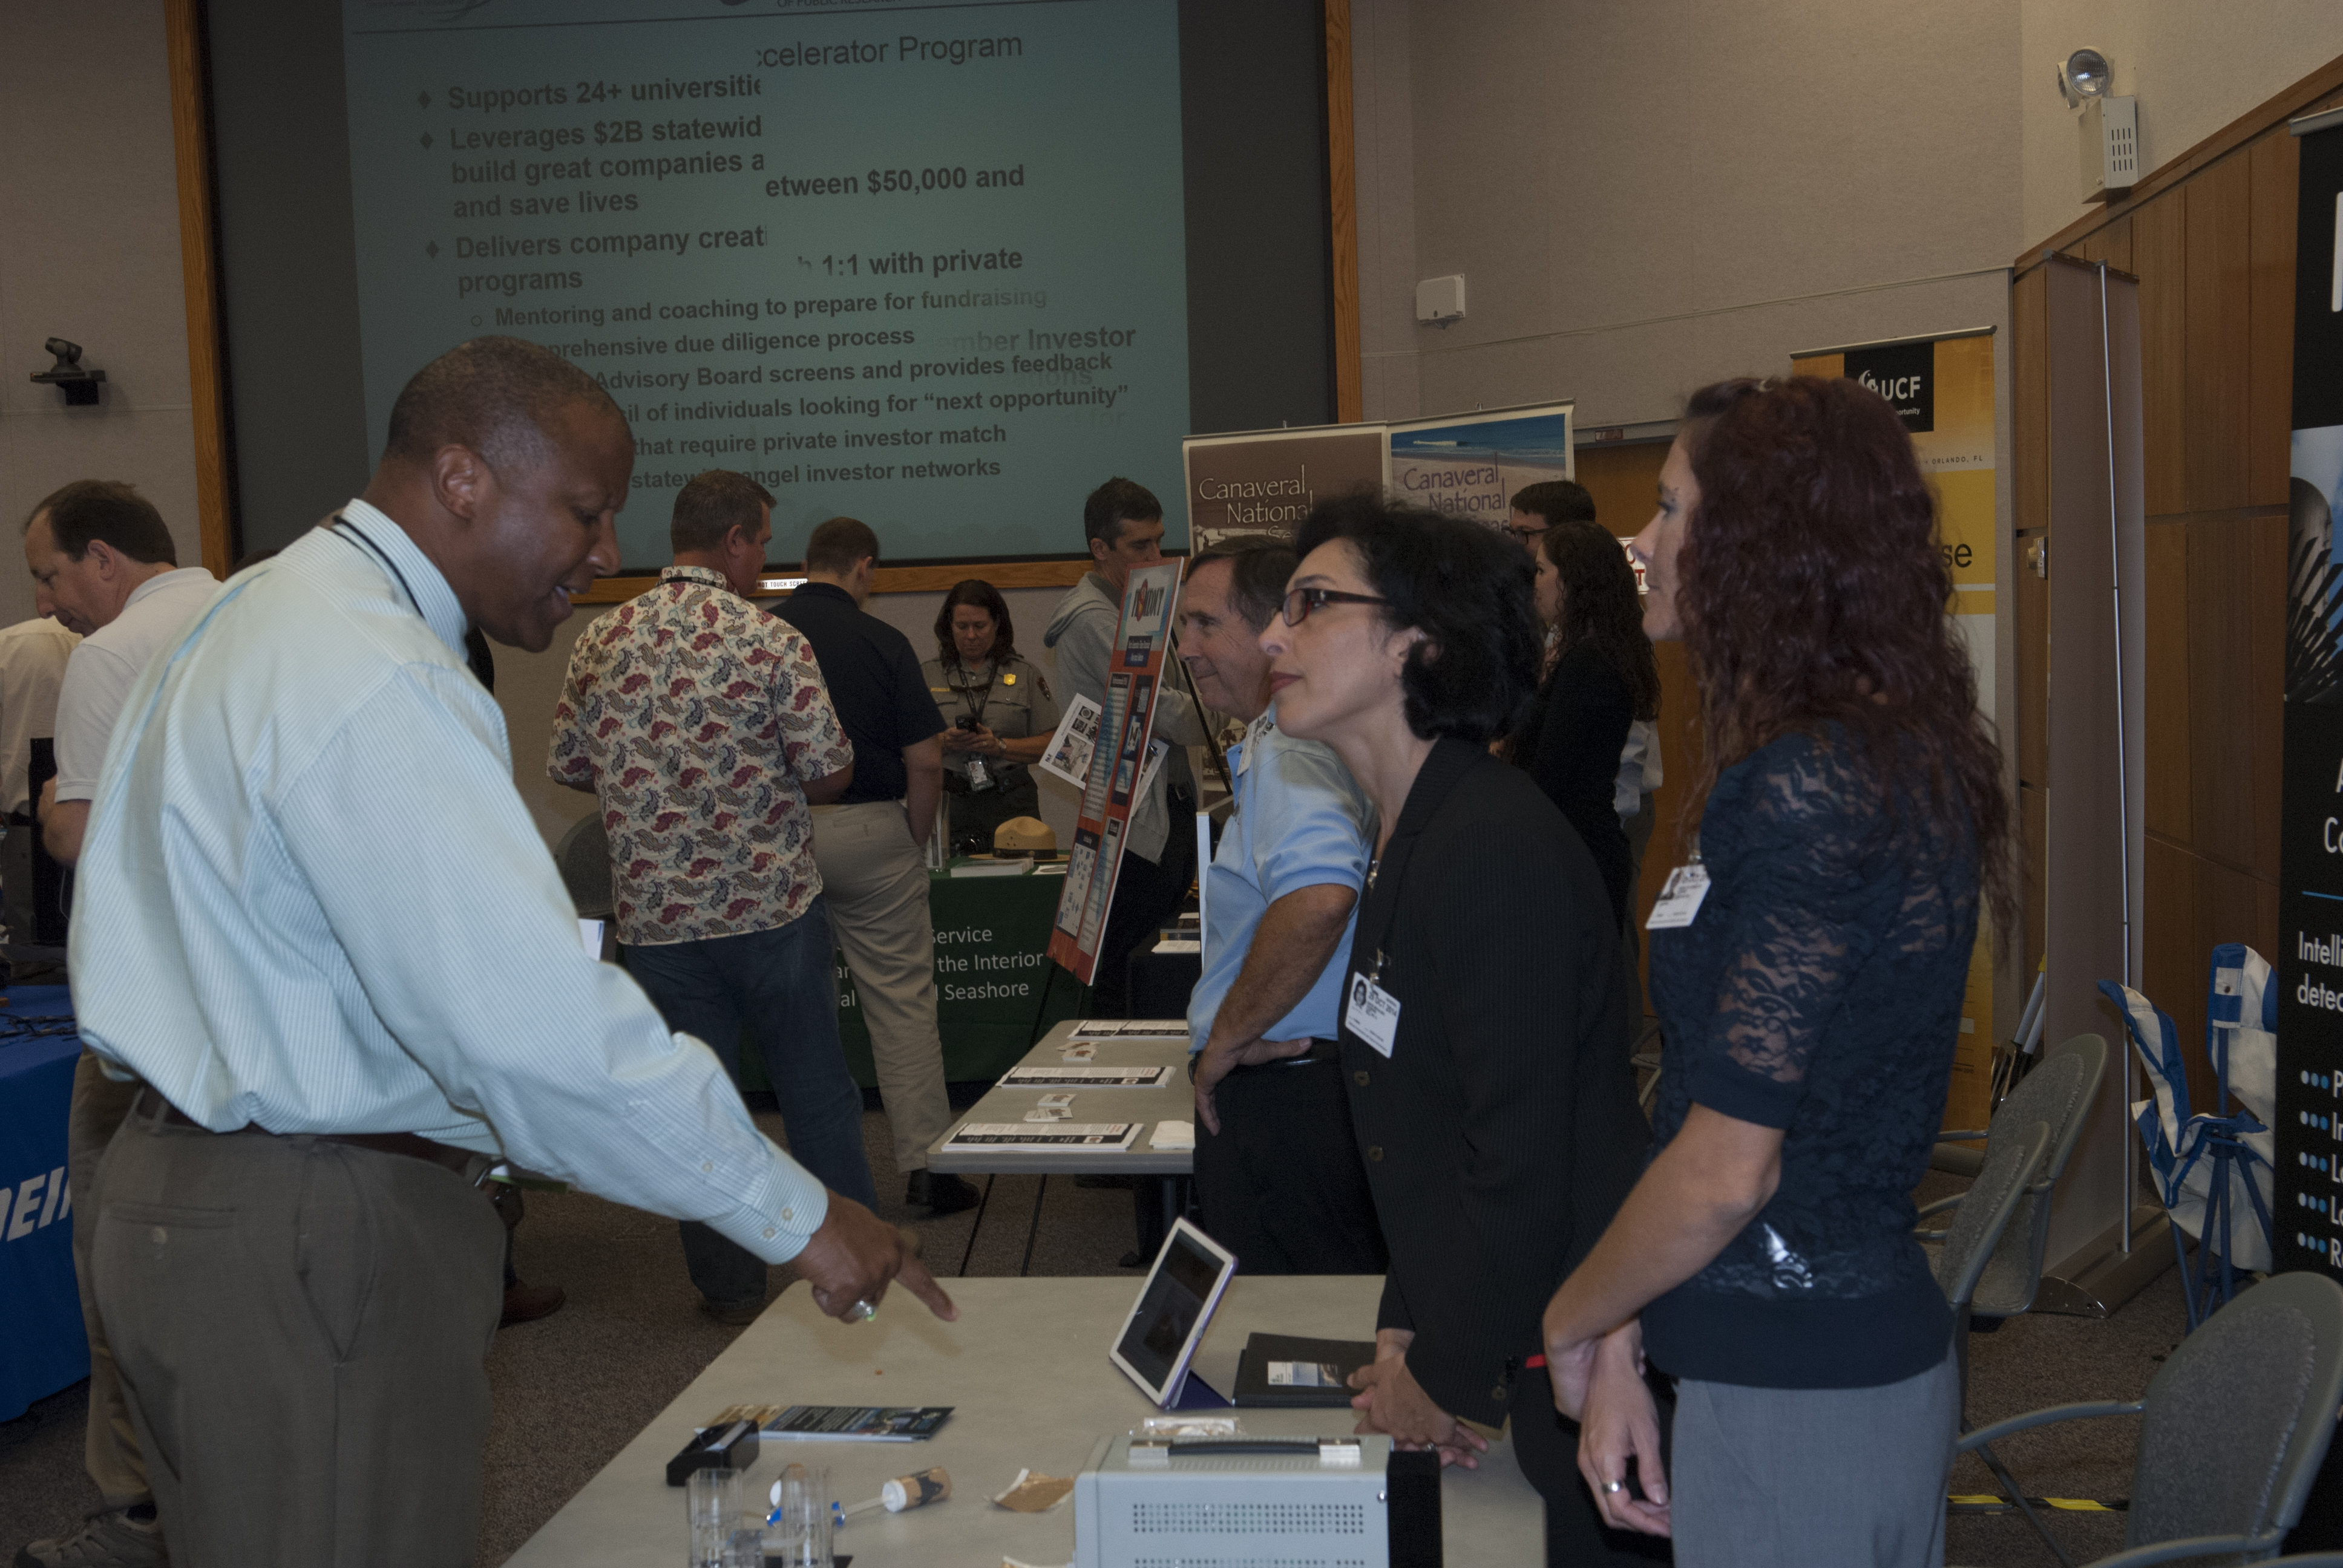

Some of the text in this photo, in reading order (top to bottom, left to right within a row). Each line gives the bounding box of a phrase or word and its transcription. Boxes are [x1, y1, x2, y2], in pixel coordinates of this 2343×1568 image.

[756, 36, 1023, 68] celerator Program
[448, 83, 568, 114] Supports
[576, 80, 622, 104] 24+
[450, 127, 586, 152] Leverages
[594, 120, 643, 146] $2B
[451, 159, 516, 184] build
[525, 157, 592, 186] great
[600, 151, 743, 181] companies
[867, 166, 967, 195] $50,000
[975, 164, 1024, 188] and
[453, 191, 639, 218] and save lives
[456, 225, 765, 259] Delivers company creat
[822, 253, 858, 276] 1:1
[868, 251, 923, 275] with
[932, 248, 1023, 278] private
[458, 271, 583, 299] programs
[495, 289, 1046, 327] Mentoring and coaching to prepare for fundraising
[674, 335, 715, 353] due
[721, 332, 821, 355] diligence
[827, 330, 915, 352] process
[1029, 327, 1136, 351] Investor
[595, 351, 1112, 391] Advisory Board screens and provides feedback
[646, 402, 669, 422] of
[675, 398, 793, 420] individuals
[799, 395, 880, 418] looking
[886, 394, 918, 413] for
[924, 391, 983, 411] “next
[989, 385, 1128, 413] opportunity”
[1881, 376, 1921, 400] UCF
[634, 423, 1006, 458] that require private investor match
[807, 463, 895, 483] investor
[901, 457, 1001, 479] networks
[1199, 463, 1305, 500] Canaveral
[1404, 452, 1499, 491] Canaveral
[1227, 489, 1313, 524] National
[1429, 477, 1506, 514] National
[937, 954, 968, 973] the
[974, 952, 1044, 971] Interior
[945, 981, 1029, 1001] Seashore
